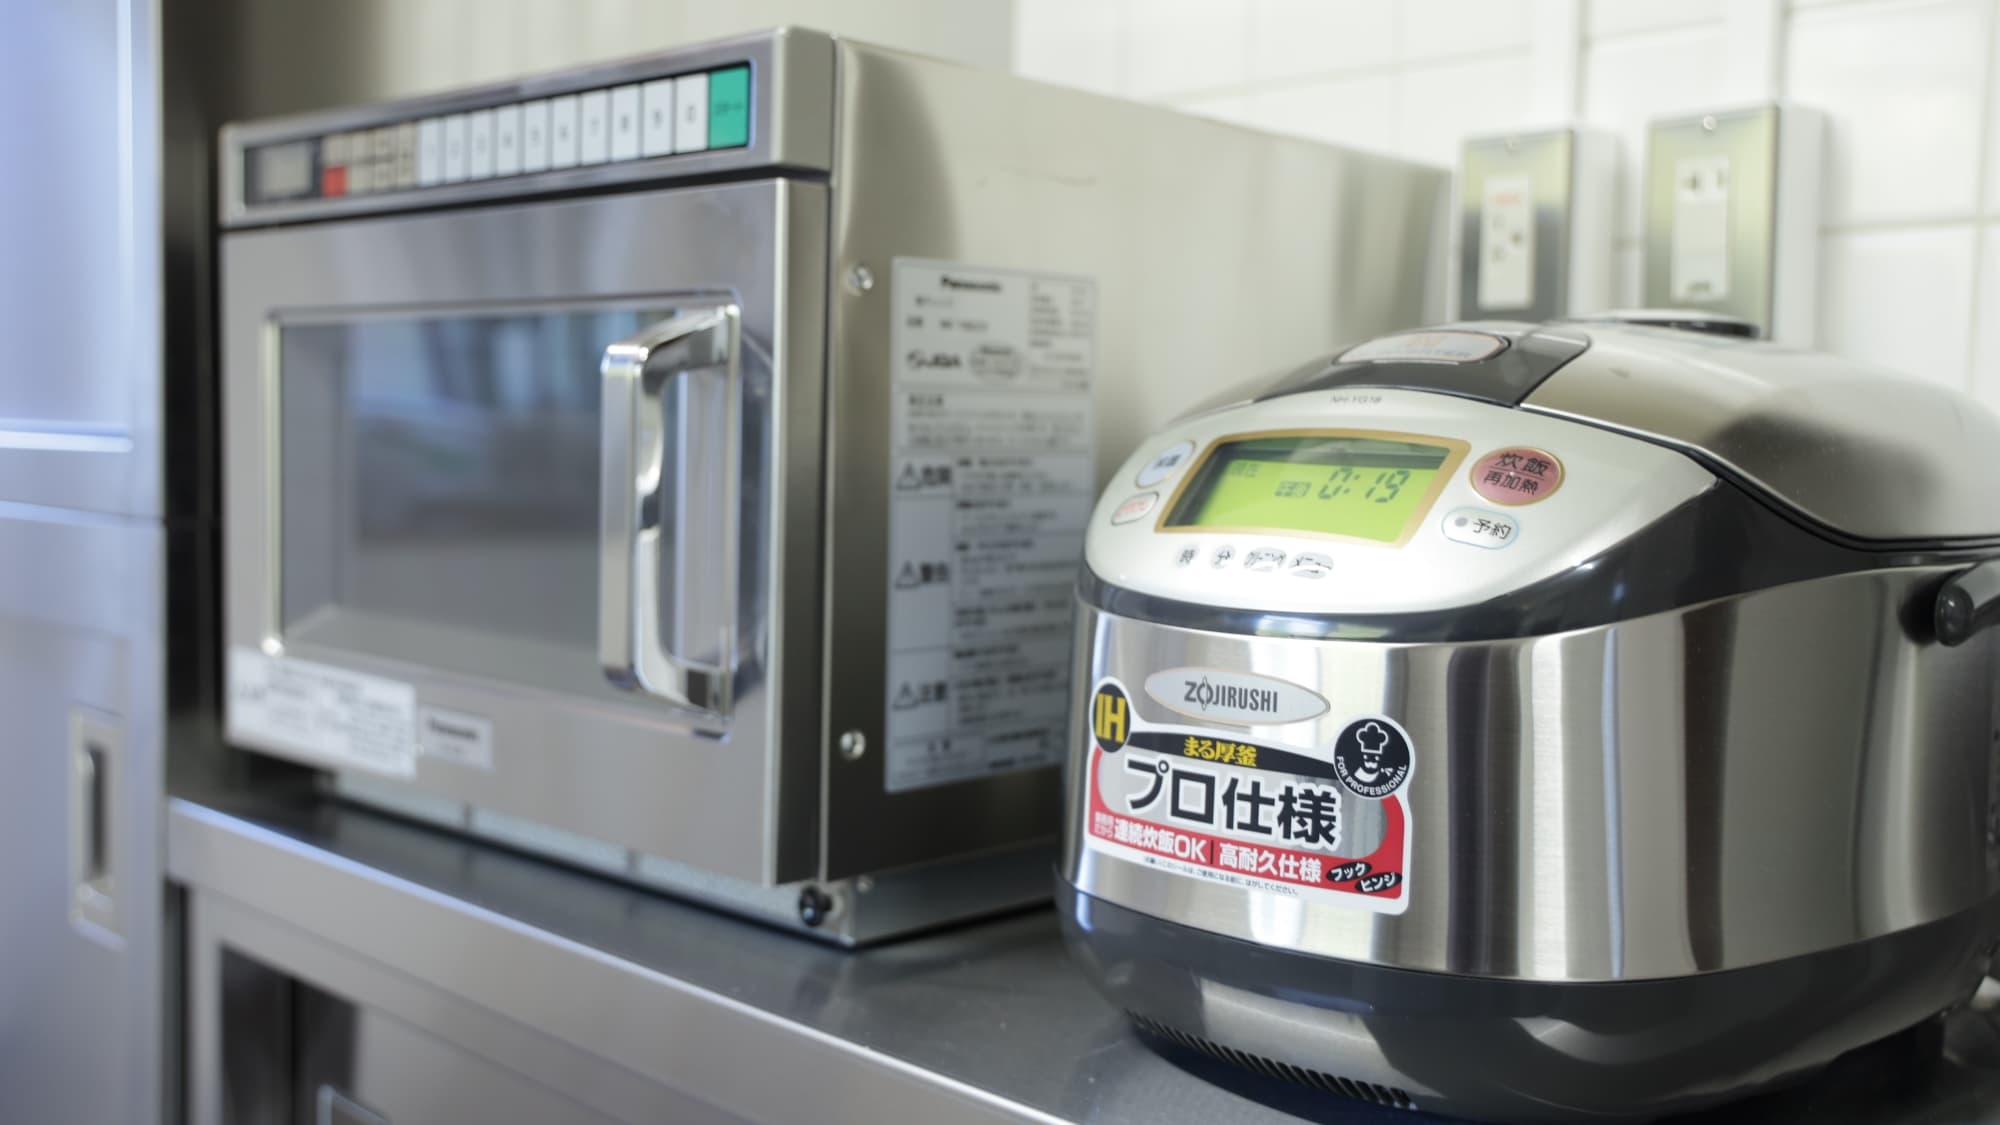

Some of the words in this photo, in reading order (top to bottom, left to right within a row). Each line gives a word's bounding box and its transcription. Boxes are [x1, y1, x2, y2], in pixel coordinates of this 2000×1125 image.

[1495, 452, 1551, 477] 炊飯
[1318, 467, 1410, 503] 0:19
[1483, 470, 1539, 496] 再加熱
[1472, 518, 1512, 540] 予約
[1184, 676, 1279, 713] ZOJIRUSHI
[1095, 692, 1126, 744] IH
[1182, 737, 1258, 768] まる厚釜
[1336, 755, 1349, 777] FOR
[1345, 764, 1407, 796] PROFESSIONAL
[1127, 759, 1337, 846] プロ仕様
[1114, 817, 1207, 863] 連続炊飯OK
[1219, 842, 1322, 883] 高耐久仕様
[1331, 862, 1367, 881] フック
[1360, 872, 1397, 893] ヒンジ
